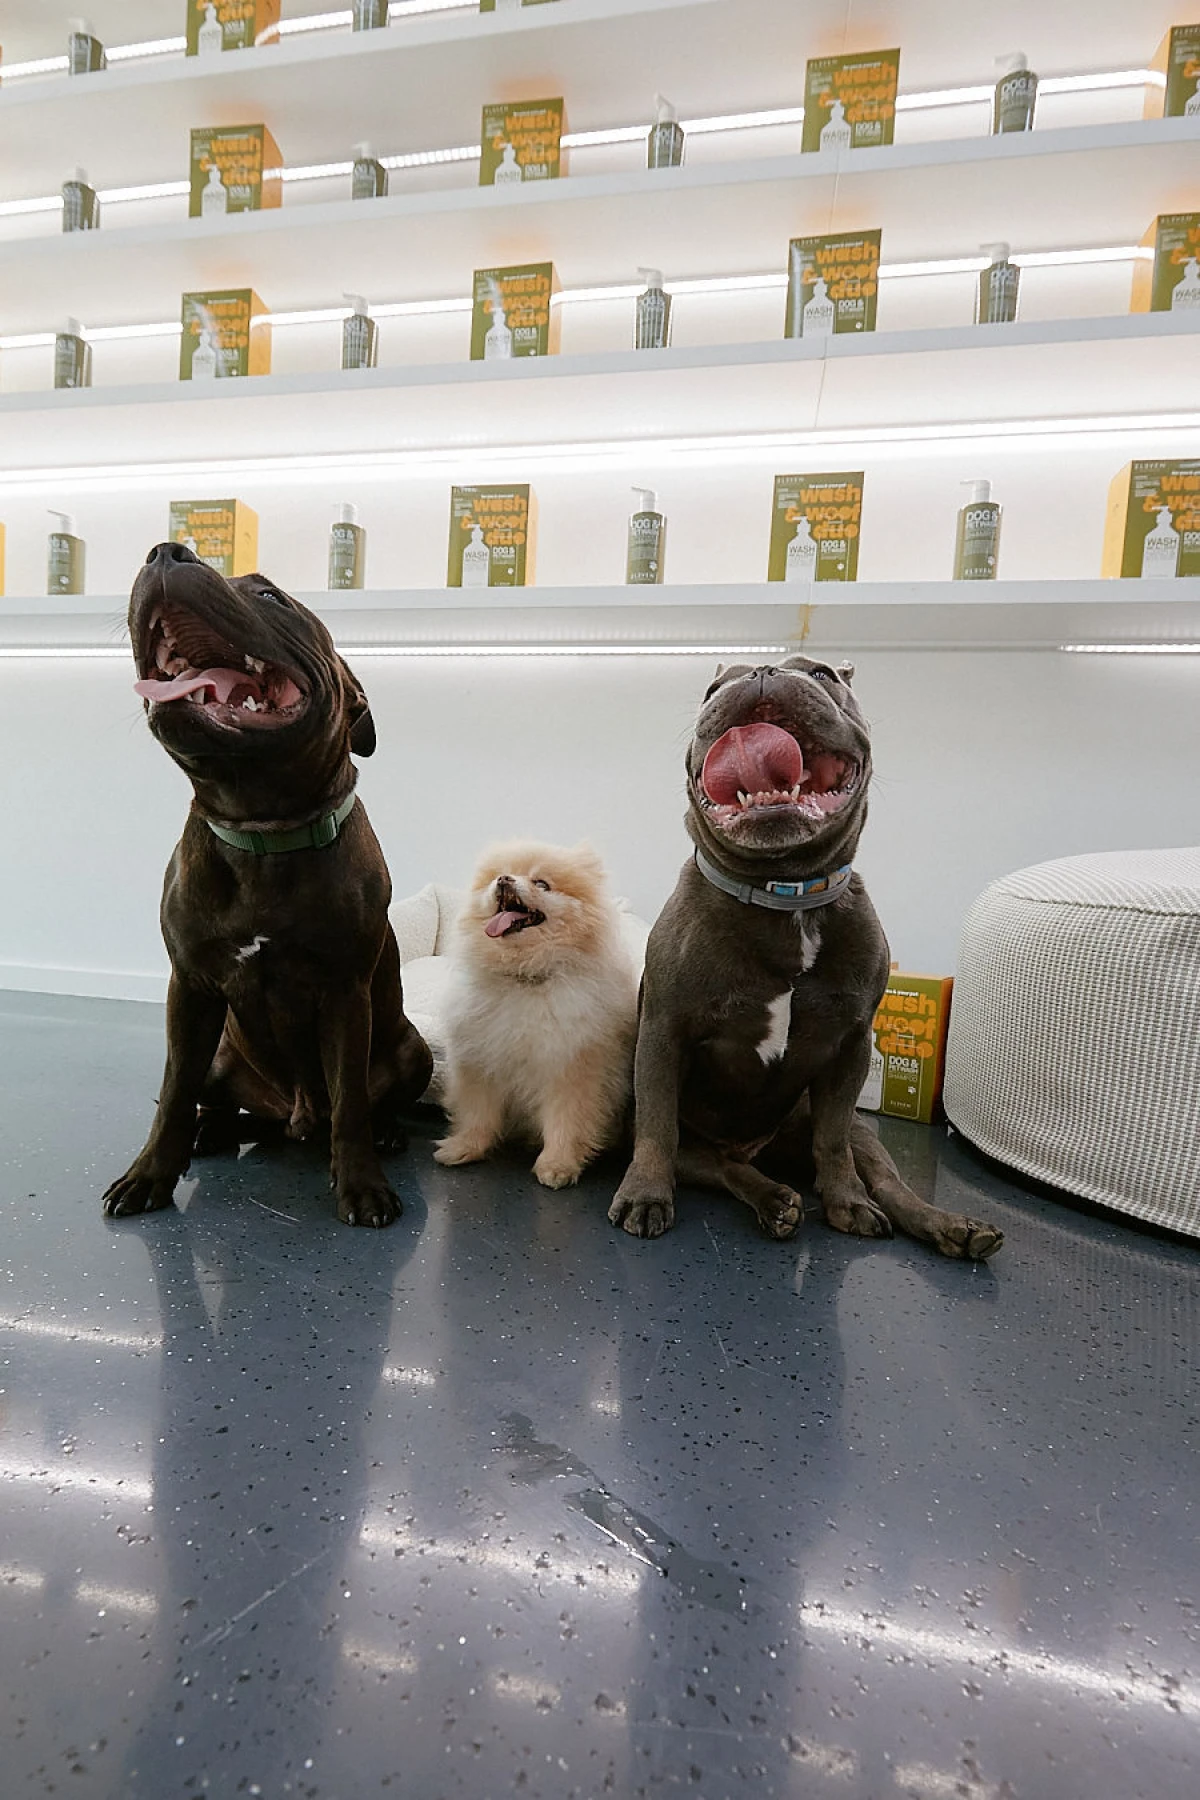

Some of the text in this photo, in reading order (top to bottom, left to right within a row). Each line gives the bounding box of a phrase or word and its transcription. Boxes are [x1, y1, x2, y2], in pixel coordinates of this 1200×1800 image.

[833, 61, 897, 86] wash
[839, 82, 897, 105] woof
[505, 109, 560, 132] wash
[847, 103, 894, 123] duo
[211, 134, 261, 153] wash
[517, 147, 558, 165] duo
[816, 241, 878, 264] wash
[822, 260, 878, 282] woof
[497, 273, 549, 293] wash
[830, 280, 877, 299] duo
[1175, 287, 1200, 299] WAS
[508, 308, 547, 328] duo
[806, 306, 833, 317] WASH
[473, 494, 528, 512] wash
[800, 483, 861, 504] wash
[187, 508, 234, 525] wash
[478, 511, 527, 530] woof
[805, 503, 860, 522] woof
[967, 510, 991, 522] DOG
[485, 527, 526, 545] duo
[813, 521, 858, 540] duo
[788, 545, 816, 554] WASH
[1147, 537, 1177, 547] WASH
[873, 1014, 936, 1040] woof
[880, 1035, 935, 1058] duo
[889, 1055, 919, 1069] DOG &
